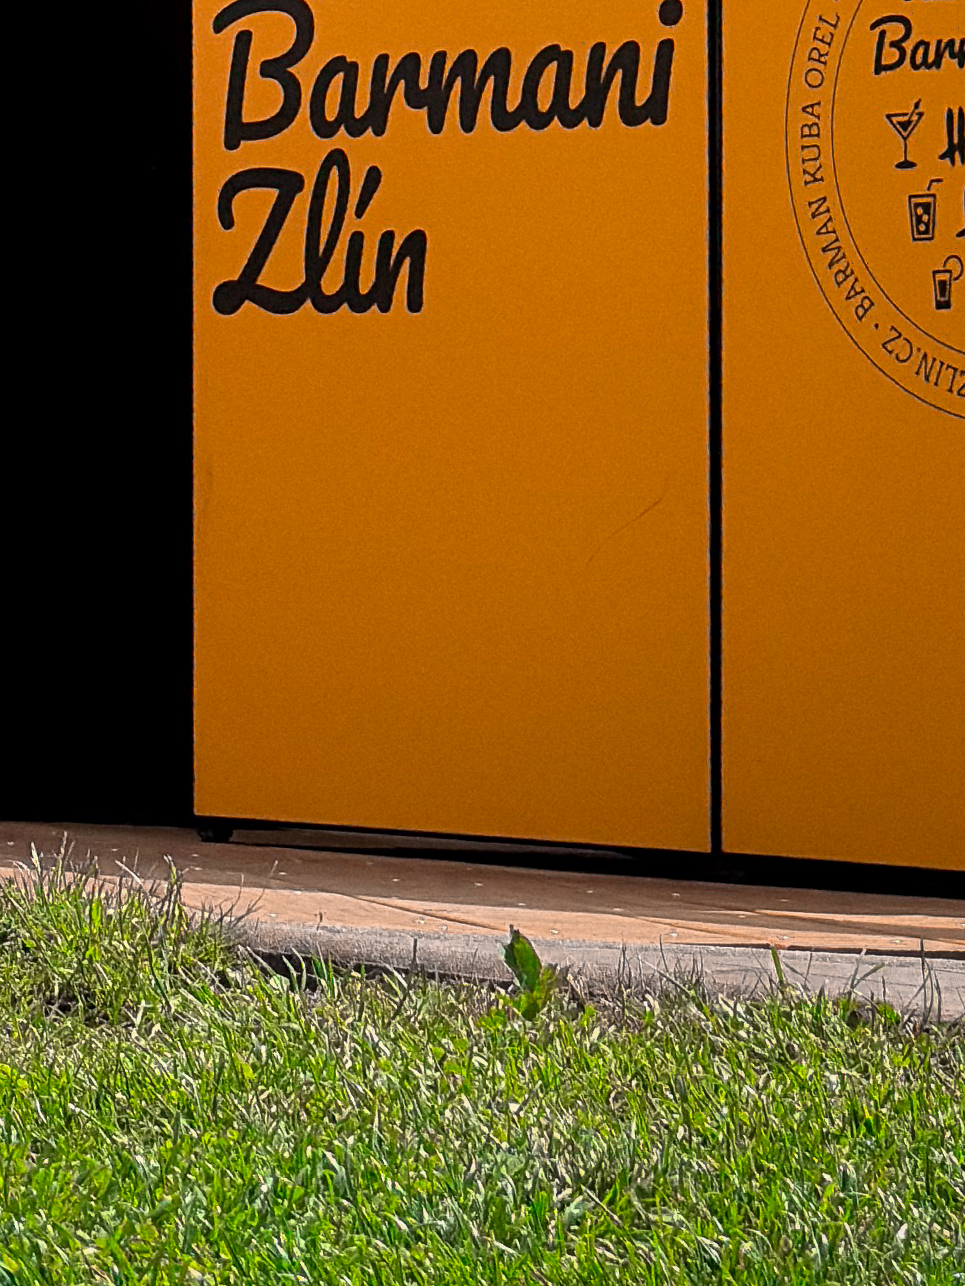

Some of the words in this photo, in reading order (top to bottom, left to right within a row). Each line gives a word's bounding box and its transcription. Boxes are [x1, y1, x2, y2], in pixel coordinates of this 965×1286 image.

[804, 13, 841, 89] OREL
[800, 100, 825, 187] KUBA
[212, 148, 428, 315] Zlín
[808, 196, 875, 322] BARMAN
